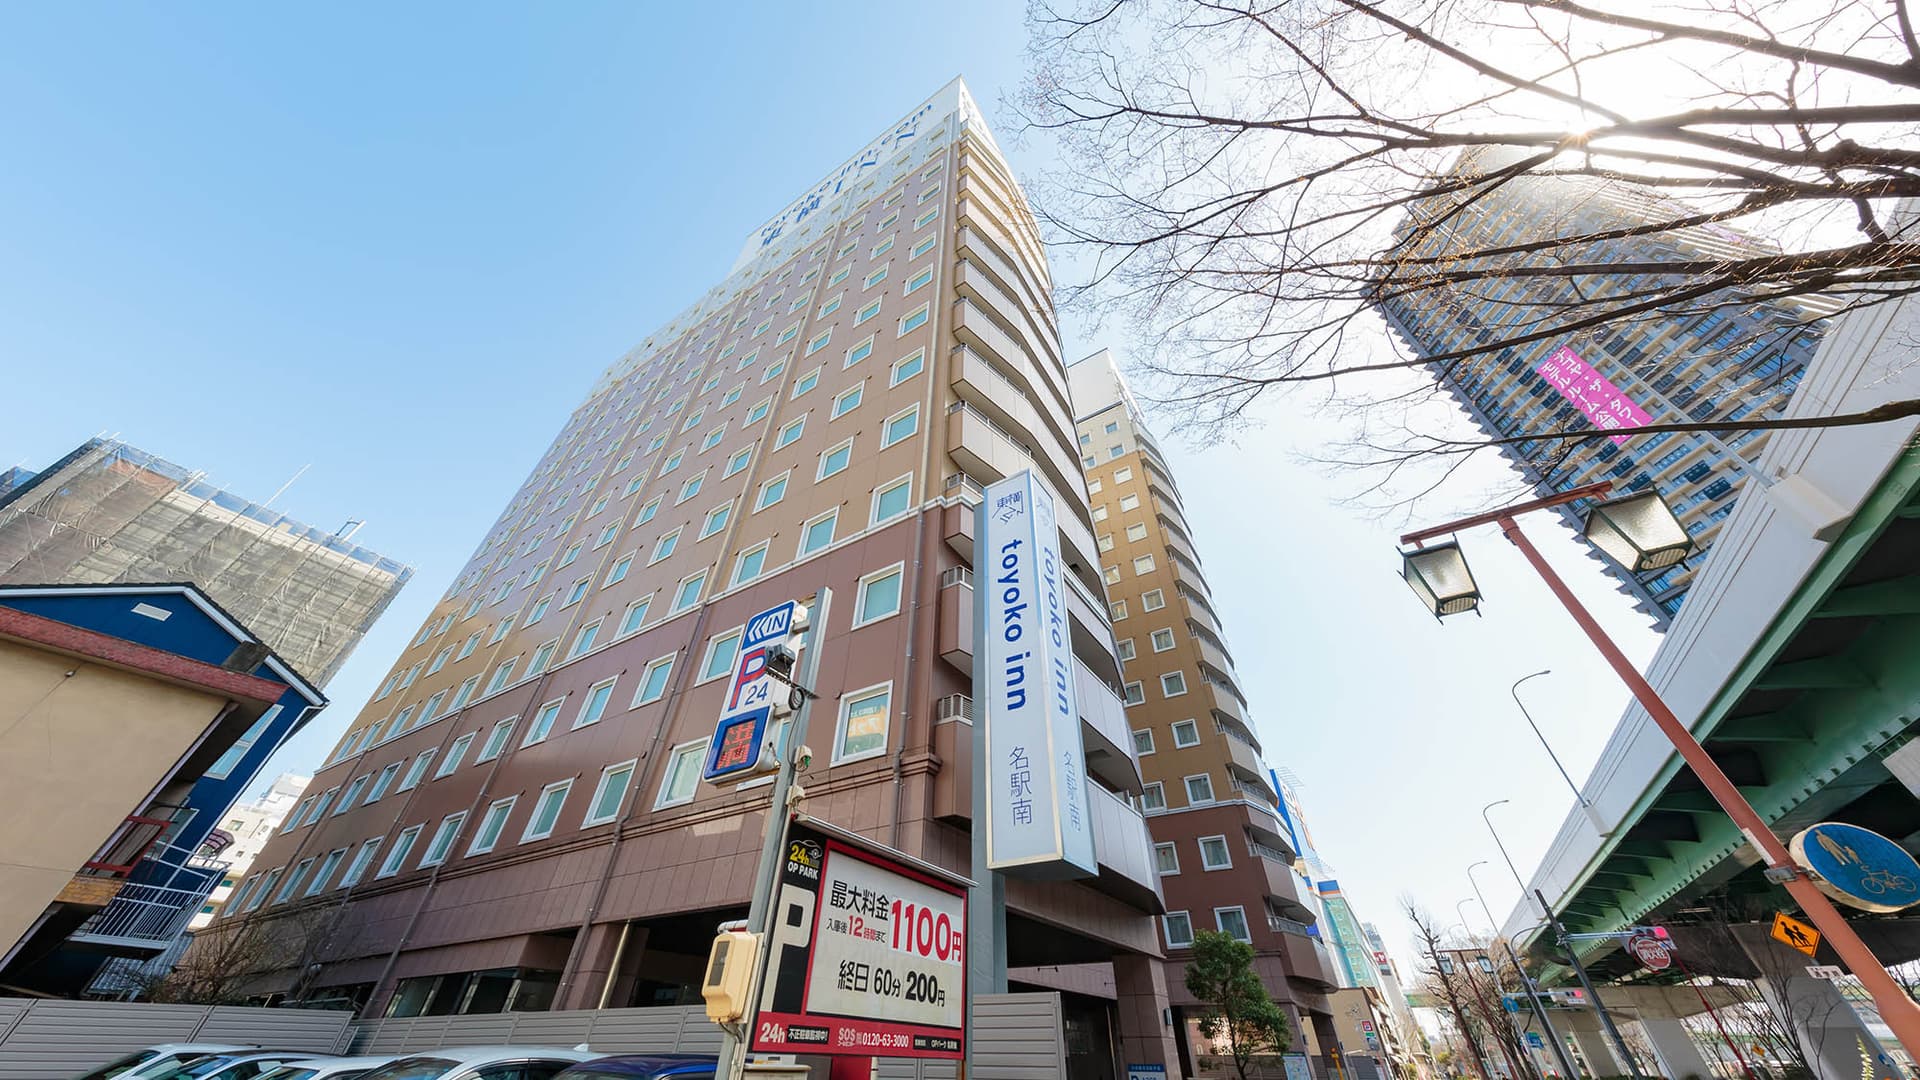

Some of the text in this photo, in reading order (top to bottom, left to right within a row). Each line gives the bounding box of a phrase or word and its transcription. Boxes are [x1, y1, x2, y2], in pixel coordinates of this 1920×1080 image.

[766, 612, 787, 633] IN
[997, 538, 1031, 711] toyoko inn
[1044, 546, 1069, 716] toyoko inn
[728, 647, 768, 712] P
[744, 681, 769, 706] 24
[1009, 746, 1032, 827] 名駅南
[787, 861, 799, 873] OP
[799, 864, 819, 881] PARK
[760, 883, 816, 1013] P
[830, 880, 962, 962] 最大料金 1100円
[837, 960, 945, 1007] 終日 60分 200円
[759, 1022, 786, 1044] 24h
[838, 1027, 856, 1041] SOS
[862, 1032, 909, 1048] 0120-63-3000
